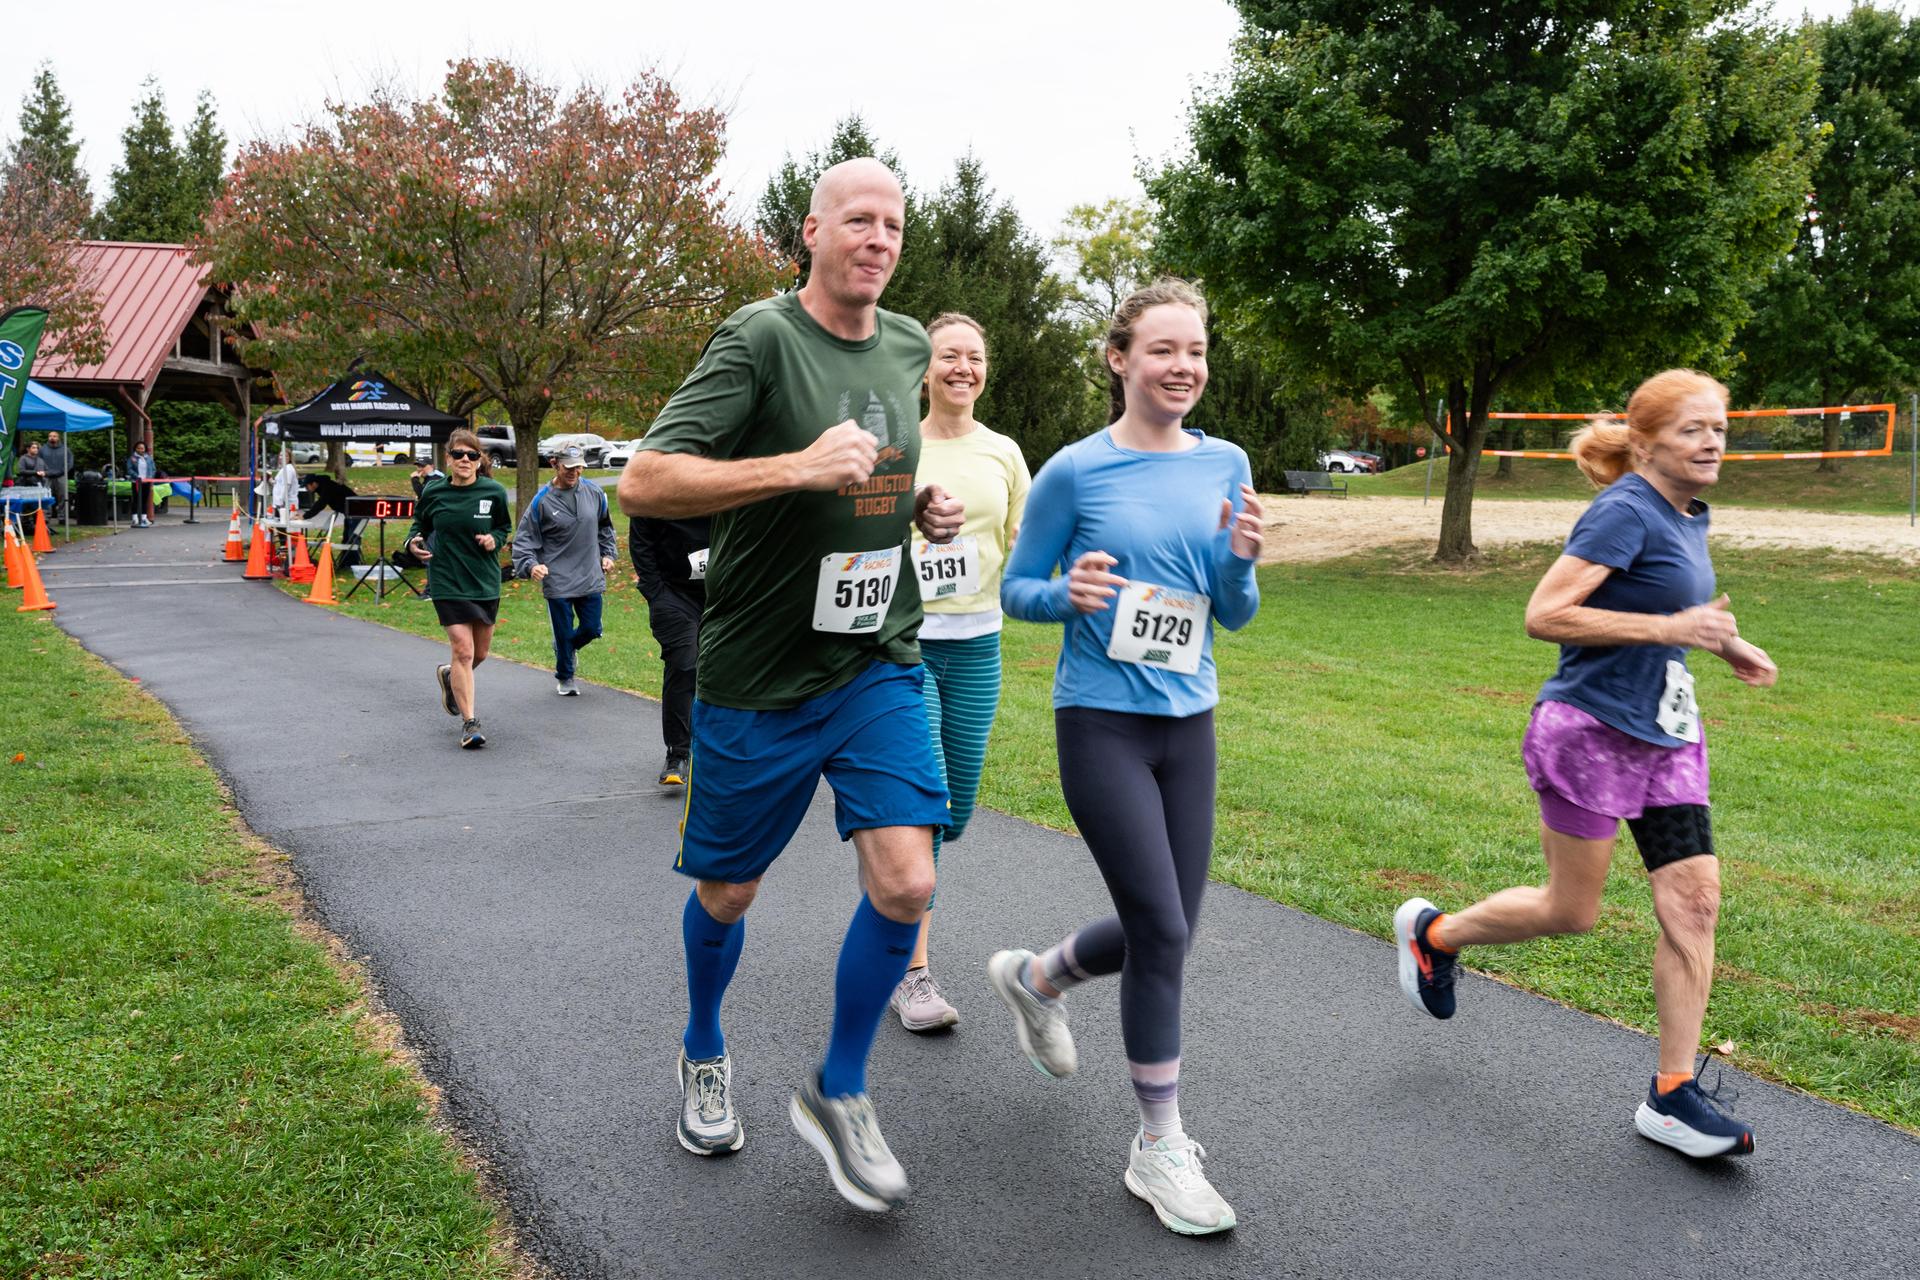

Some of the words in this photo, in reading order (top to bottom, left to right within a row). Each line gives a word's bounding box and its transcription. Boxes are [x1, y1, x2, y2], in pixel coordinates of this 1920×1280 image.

[373, 402, 400, 410] RACING
[320, 422, 431, 438] www.brynmawrracing.com
[855, 496, 897, 517] RUGBY
[920, 556, 966, 581] 5131
[835, 575, 891, 608] 5130
[1132, 609, 1193, 646] 5129
